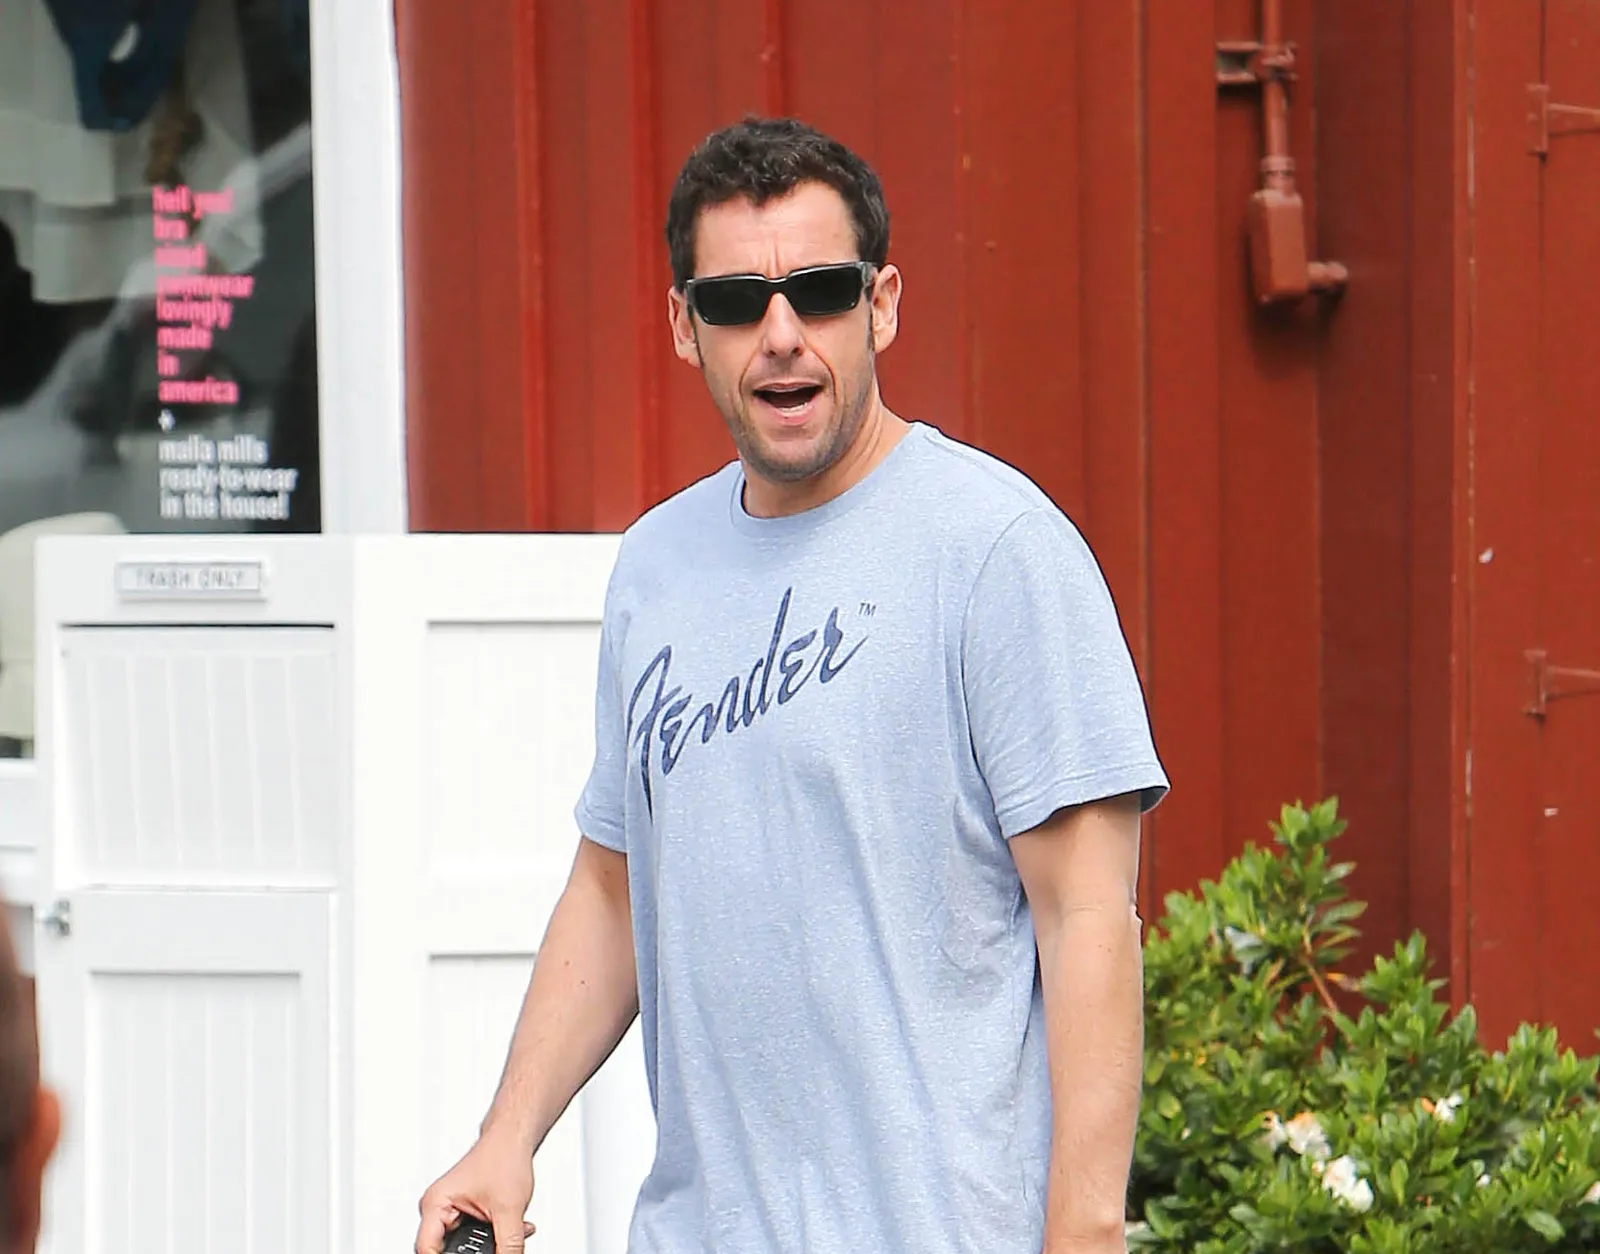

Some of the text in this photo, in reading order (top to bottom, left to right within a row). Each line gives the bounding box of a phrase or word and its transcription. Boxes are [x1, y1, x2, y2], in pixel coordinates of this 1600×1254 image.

[156, 272, 254, 298] imwear
[156, 295, 233, 329] lovingly
[157, 322, 213, 349] made
[157, 350, 179, 376] in
[158, 377, 239, 404] america
[217, 434, 268, 463] mills
[159, 464, 298, 494] ready-to-wear
[160, 491, 290, 520] in the house!
[135, 568, 244, 588] TRASH ONLY
[626, 586, 868, 824] Fender
